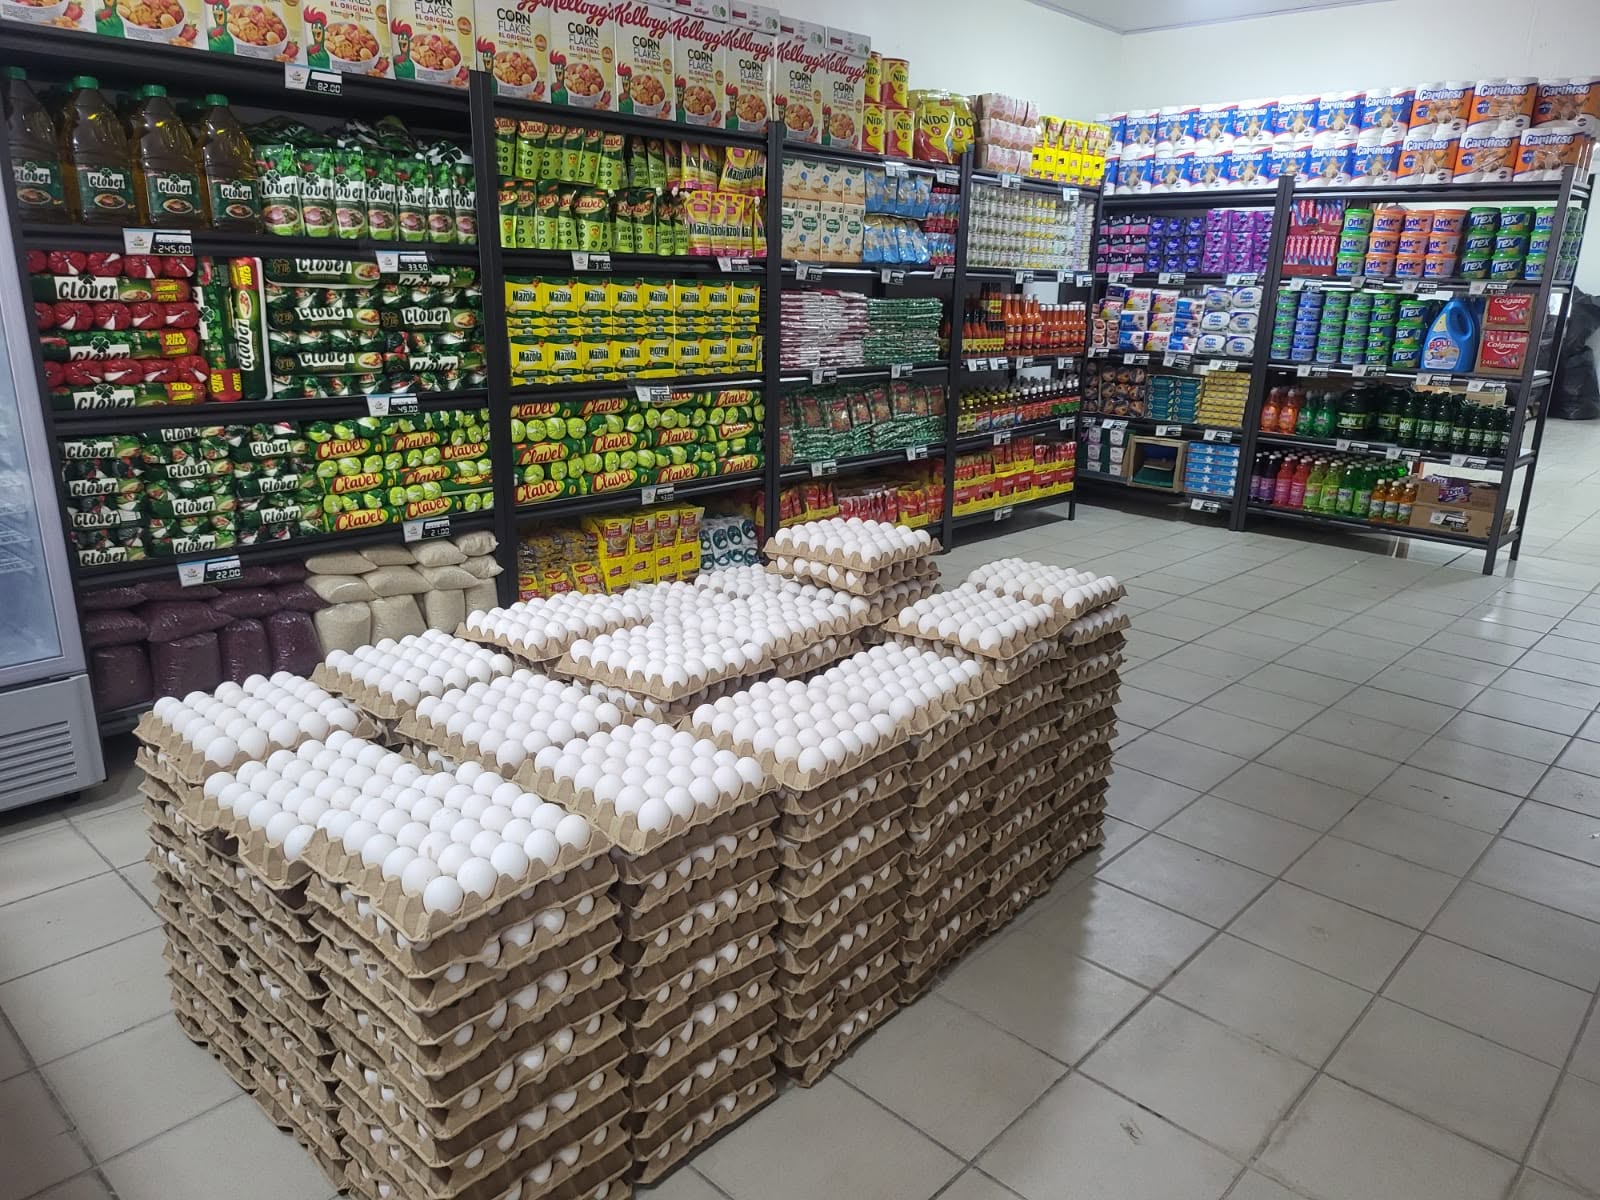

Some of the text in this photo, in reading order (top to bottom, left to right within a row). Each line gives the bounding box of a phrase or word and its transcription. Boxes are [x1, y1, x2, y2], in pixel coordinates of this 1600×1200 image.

[340, 3, 373, 14] ORIGINAL
[414, 3, 454, 18] FLAKES
[424, 15, 455, 26] ORIGINAL
[496, 8, 531, 25] CORN
[614, 2, 672, 39] Kellogg's
[498, 20, 532, 36] FLAKES
[567, 22, 599, 38] CORN
[671, 16, 726, 52] Kellogg's
[569, 34, 599, 49] FLAKES
[632, 35, 660, 50] CORN
[724, 27, 775, 63] Kellogg's
[633, 47, 661, 61] FLAKES
[687, 49, 713, 63] CORN
[777, 40, 824, 73] Kellogg's
[688, 60, 713, 73] FLAKES
[739, 59, 763, 73] CORN
[824, 53, 866, 85] Kellogg's
[740, 70, 764, 82] FLAKES
[789, 70, 812, 83] CORN
[790, 81, 812, 92] FLAKES
[833, 81, 855, 93] CORN
[1480, 84, 1528, 97] Cariñoso
[1541, 84, 1590, 97] Cariñoso
[1419, 89, 1465, 102] Cariñoso
[954, 116, 973, 127] IDO
[1406, 139, 1449, 152] Cariñoso
[1464, 137, 1512, 150] Cariñoso
[1525, 134, 1575, 147] Cariñoso
[14, 170, 50, 183] Clover
[89, 175, 125, 189] Clover
[159, 181, 193, 194] Clover
[222, 187, 252, 200] Clover
[259, 181, 297, 196] lover
[300, 182, 332, 197] lover
[336, 186, 364, 199] over
[366, 187, 395, 201] lover
[158, 245, 191, 254] 245.00
[58, 281, 117, 300] Clover
[512, 290, 536, 302] Mazola
[549, 291, 572, 302] Mazola
[585, 290, 605, 302] Mazola
[618, 291, 638, 302] Mazola
[1494, 296, 1528, 305] Colgate
[300, 308, 347, 318] Clover
[405, 309, 449, 322] Clover
[239, 320, 254, 370] Clover
[1487, 341, 1521, 350] Colgate
[301, 352, 349, 363] Clover
[519, 351, 542, 362] Mazola
[555, 350, 577, 361] Mazola
[589, 349, 609, 360] Mazola
[76, 397, 135, 411] Clover
[716, 391, 750, 407] Clavel
[581, 398, 623, 416] Clavel
[164, 427, 198, 441] Clove
[393, 431, 436, 450] Clavel
[658, 429, 694, 446] Clavel
[252, 441, 289, 455] Clover
[317, 438, 366, 460] Clavel
[592, 432, 633, 453] Clavel
[67, 445, 114, 458] Clover
[441, 443, 484, 460] Clavel
[518, 442, 563, 465] Clavel
[169, 463, 210, 478] Clover
[658, 464, 695, 483] Clavel
[720, 459, 755, 474] Clavel
[402, 466, 447, 485] Clavel
[593, 469, 633, 492] Clavel
[71, 482, 118, 496] Clover
[262, 480, 297, 493] Clover
[332, 474, 380, 494] Clavel
[514, 479, 559, 504] Clavel
[175, 499, 214, 514] Clover
[406, 498, 450, 518] Clavel
[74, 513, 120, 527] Clover
[264, 509, 300, 524] Clover
[336, 509, 384, 531] Clavel
[175, 538, 215, 554] Clover
[82, 551, 127, 567] Clover
[216, 568, 241, 581] 22.00
